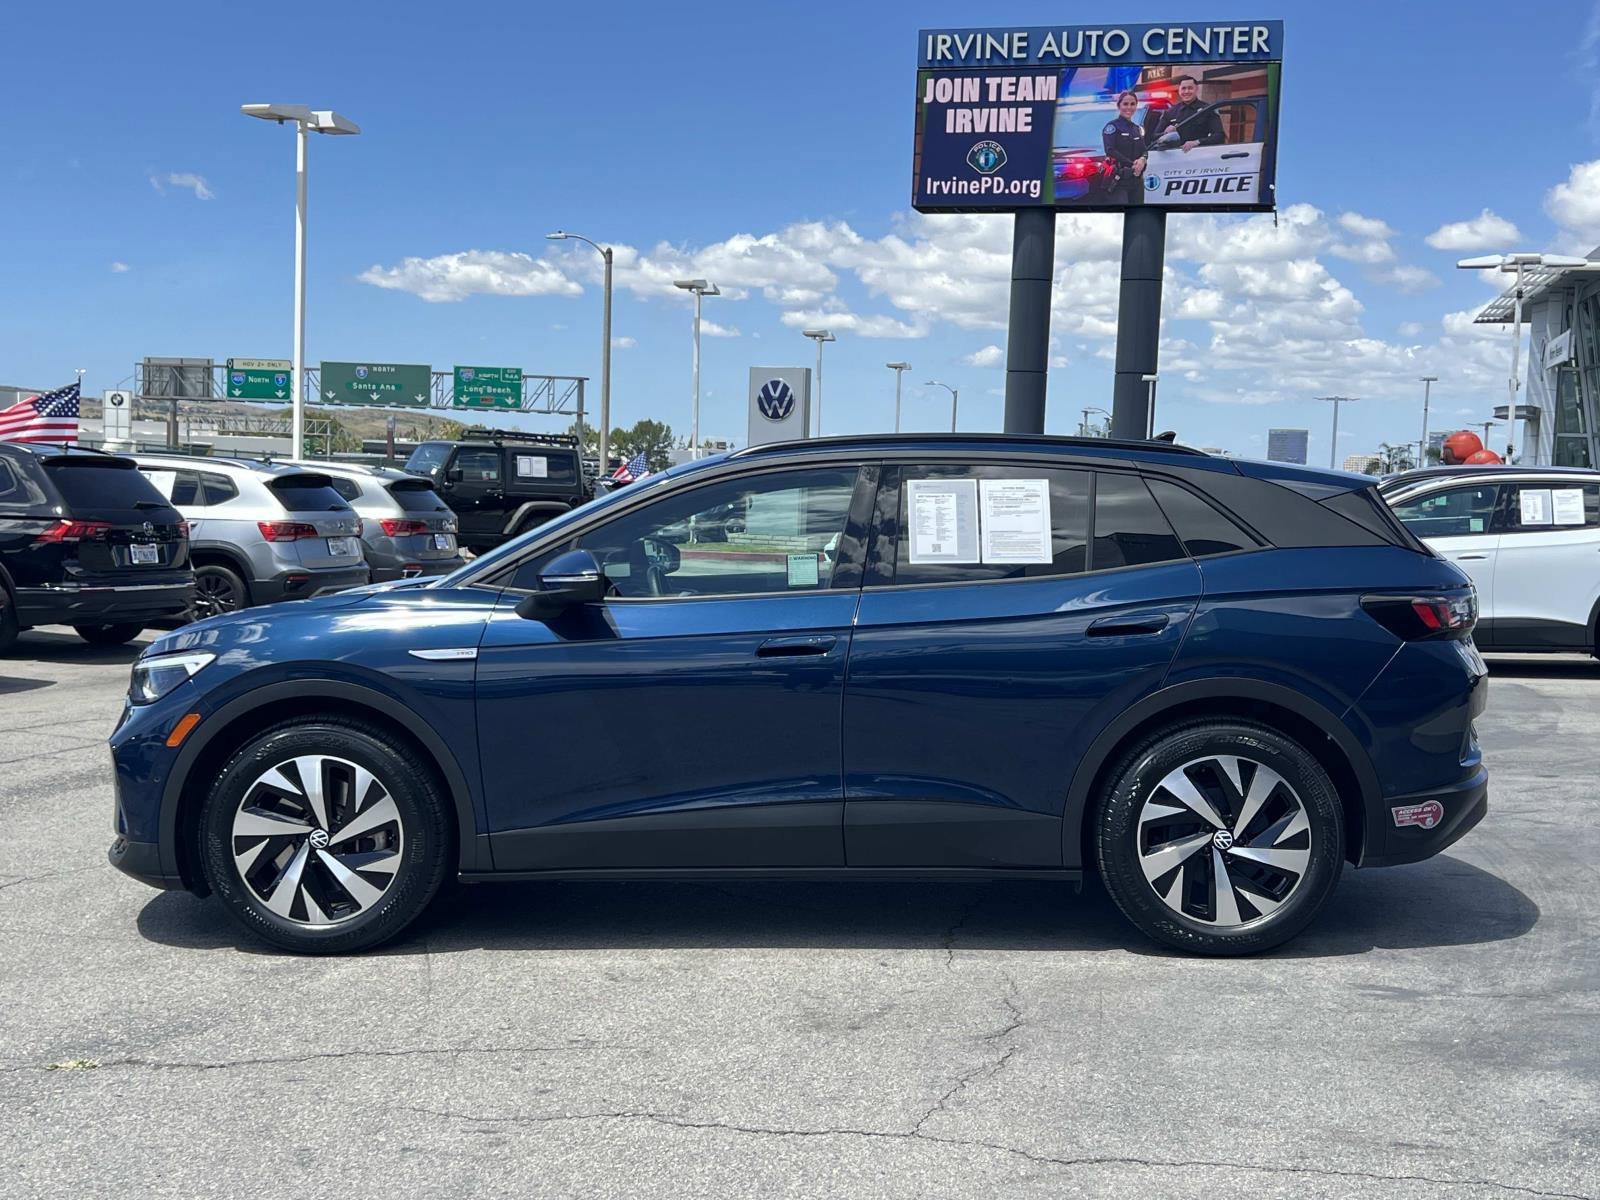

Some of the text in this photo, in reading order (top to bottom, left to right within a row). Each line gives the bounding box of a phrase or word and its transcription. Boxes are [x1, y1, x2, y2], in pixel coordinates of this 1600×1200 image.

[926, 26, 1270, 61] IRVINE AUTO CENTER
[923, 75, 1057, 104] JOIN TEAM
[945, 107, 1033, 134] IRVINE
[973, 142, 1002, 153] POLICE
[1200, 166, 1231, 174] IRVINE
[926, 176, 1041, 198] IrvinePD.org
[1164, 175, 1253, 196] POLICE
[352, 382, 396, 391] Santa Ana
[463, 385, 511, 395] Long Beach
